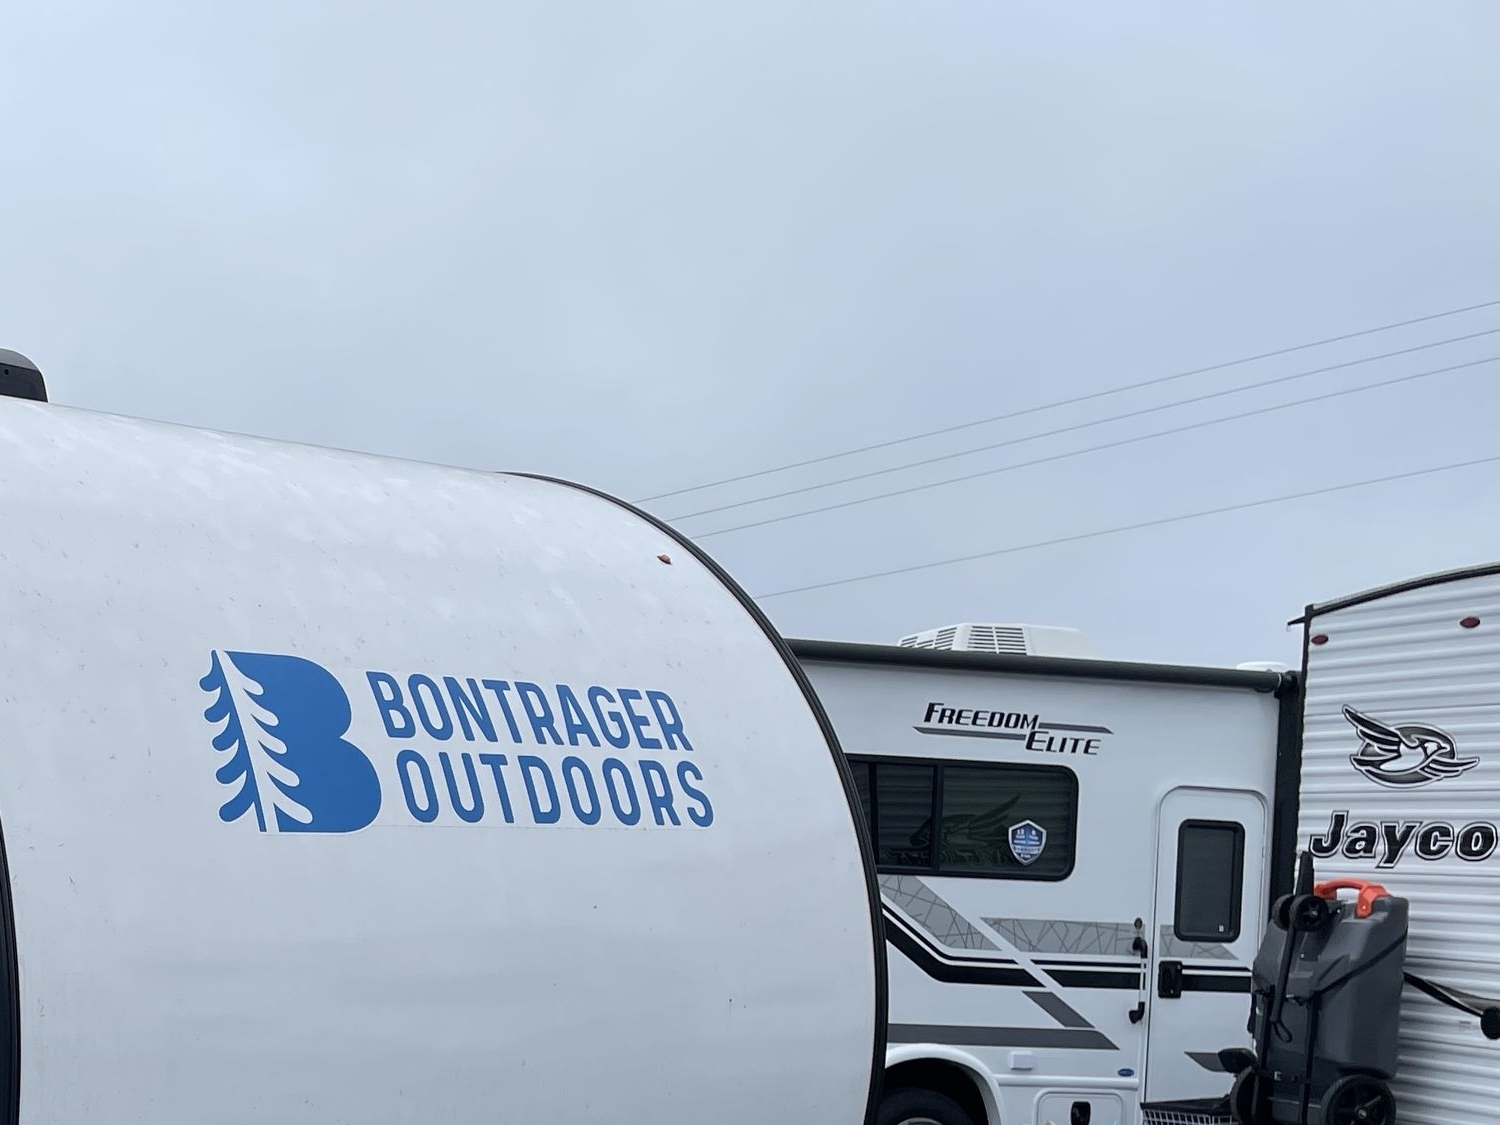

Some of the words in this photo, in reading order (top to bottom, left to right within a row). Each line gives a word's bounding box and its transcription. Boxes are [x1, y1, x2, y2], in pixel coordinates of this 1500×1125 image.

[366, 671, 694, 751] BONTRAGER
[923, 702, 1039, 731] FREEDOM
[1025, 731, 1102, 756] ELITE
[397, 749, 715, 828] OUTDOORS
[1309, 810, 1498, 869] Jayco
